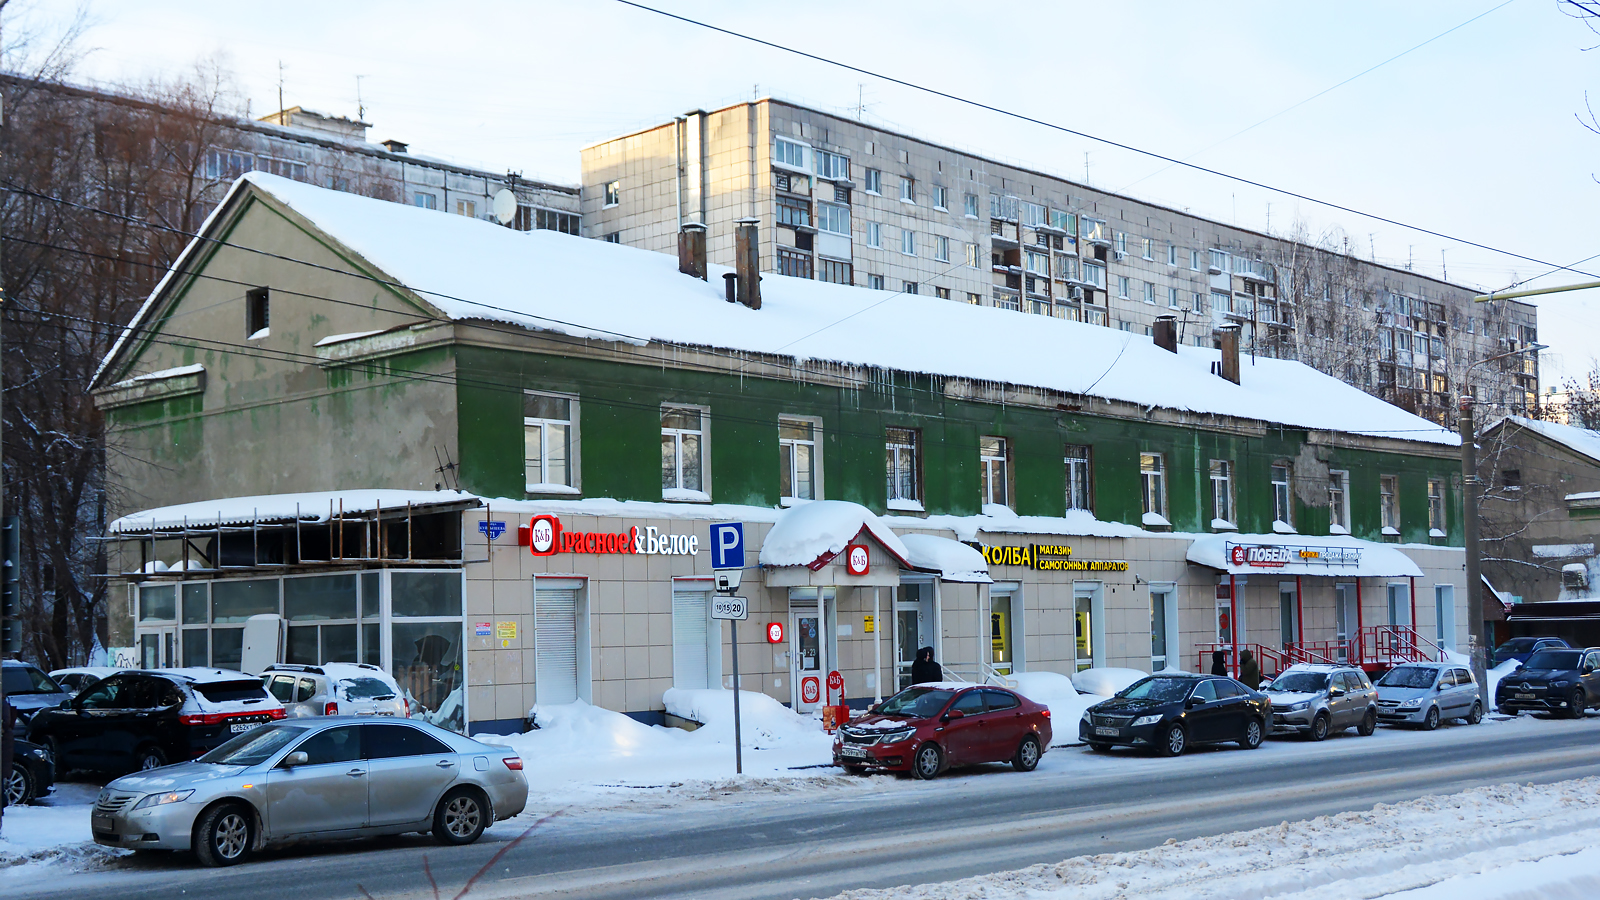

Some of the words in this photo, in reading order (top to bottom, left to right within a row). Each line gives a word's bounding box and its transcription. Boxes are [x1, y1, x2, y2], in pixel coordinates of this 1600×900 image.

[534, 528, 550, 543] К&Б
[718, 526, 740, 565] P
[1040, 545, 1072, 555] МАГАЗИН
[982, 545, 1031, 565] КОЛБА
[1235, 549, 1244, 558] 24
[1250, 547, 1293, 562] ПОБЕДА
[1040, 560, 1088, 571] САМОГОННЫХ
[1090, 561, 1129, 571] АППАРАТОВ
[732, 603, 741, 613] 20
